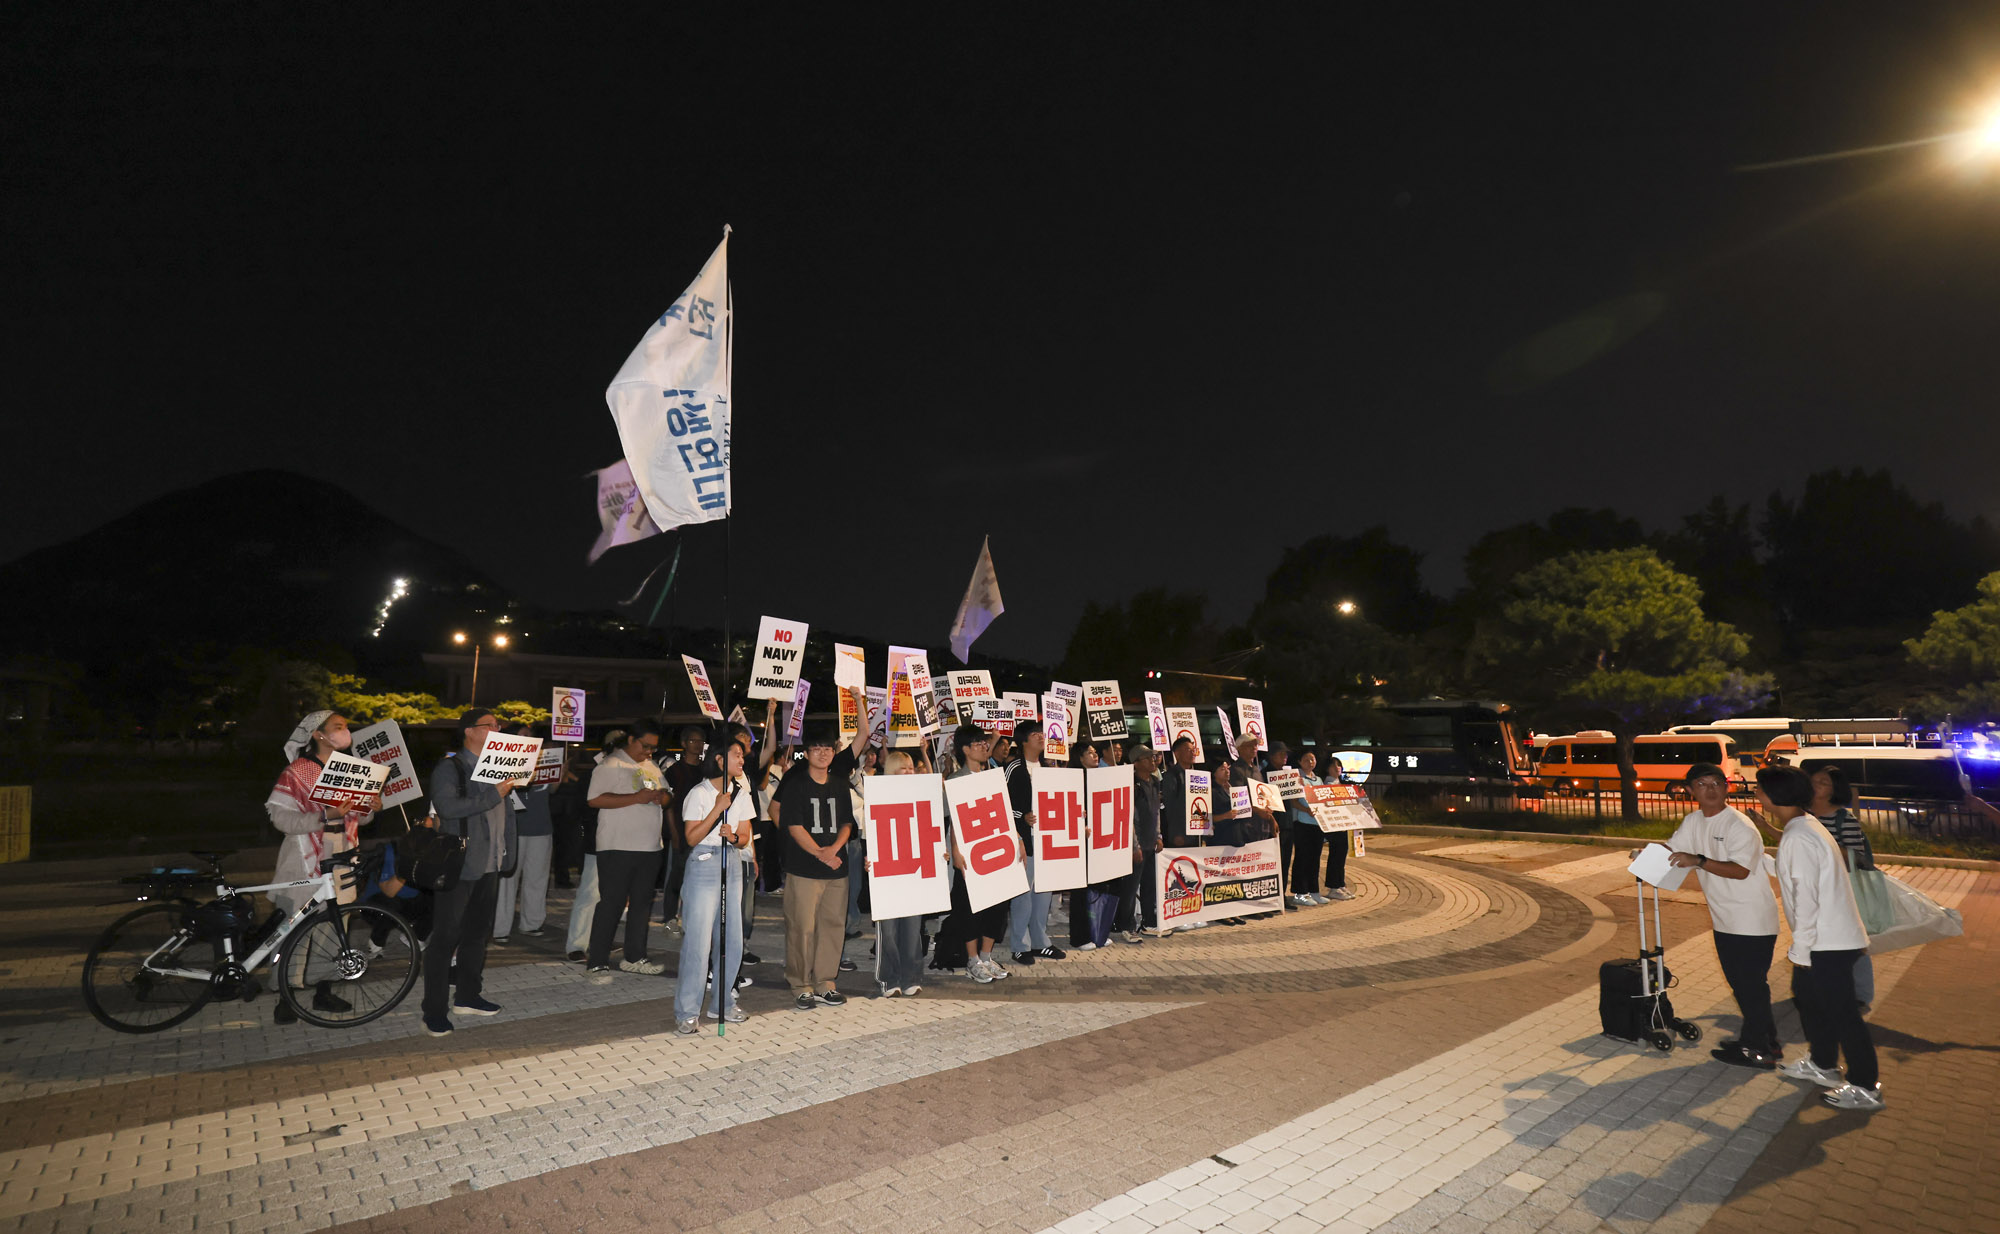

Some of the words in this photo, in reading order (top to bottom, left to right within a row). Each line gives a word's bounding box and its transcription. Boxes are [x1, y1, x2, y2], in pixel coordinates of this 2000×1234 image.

[774, 629, 793, 643] NO
[762, 646, 798, 662] NAVY
[772, 665, 783, 675] TO
[755, 677, 795, 689] HORMUZ!
[957, 675, 982, 685] 미국의
[955, 687, 972, 697] 파병
[973, 686, 990, 696] 압박
[1090, 686, 1112, 695] 정부는
[978, 700, 999, 709] 국민을
[1088, 697, 1103, 706] 파병
[1103, 696, 1119, 706] 요구
[987, 709, 1014, 719] 전쟁터에
[1021, 709, 1034, 718] 요구
[1091, 711, 1111, 724] 거부
[1100, 720, 1125, 735] 하라!
[355, 730, 391, 758] 침략을
[487, 740, 503, 751] DO
[504, 742, 524, 753] NOT
[523, 743, 539, 753] JOIN
[482, 755, 491, 764] A
[494, 756, 518, 767] WAR
[518, 758, 528, 767] OF
[1388, 755, 1418, 768] 경찰
[328, 760, 372, 778] 대미투자,
[320, 773, 365, 790] 파병압박
[810, 797, 837, 834] 11
[1092, 786, 1130, 851] 대
[1037, 791, 1083, 861] 반
[869, 800, 942, 879] 파
[955, 791, 1016, 876] 병
[1205, 883, 1244, 902] 파병반대
[1243, 877, 1278, 899] 평화행진
[1165, 895, 1201, 917] 파병반대
